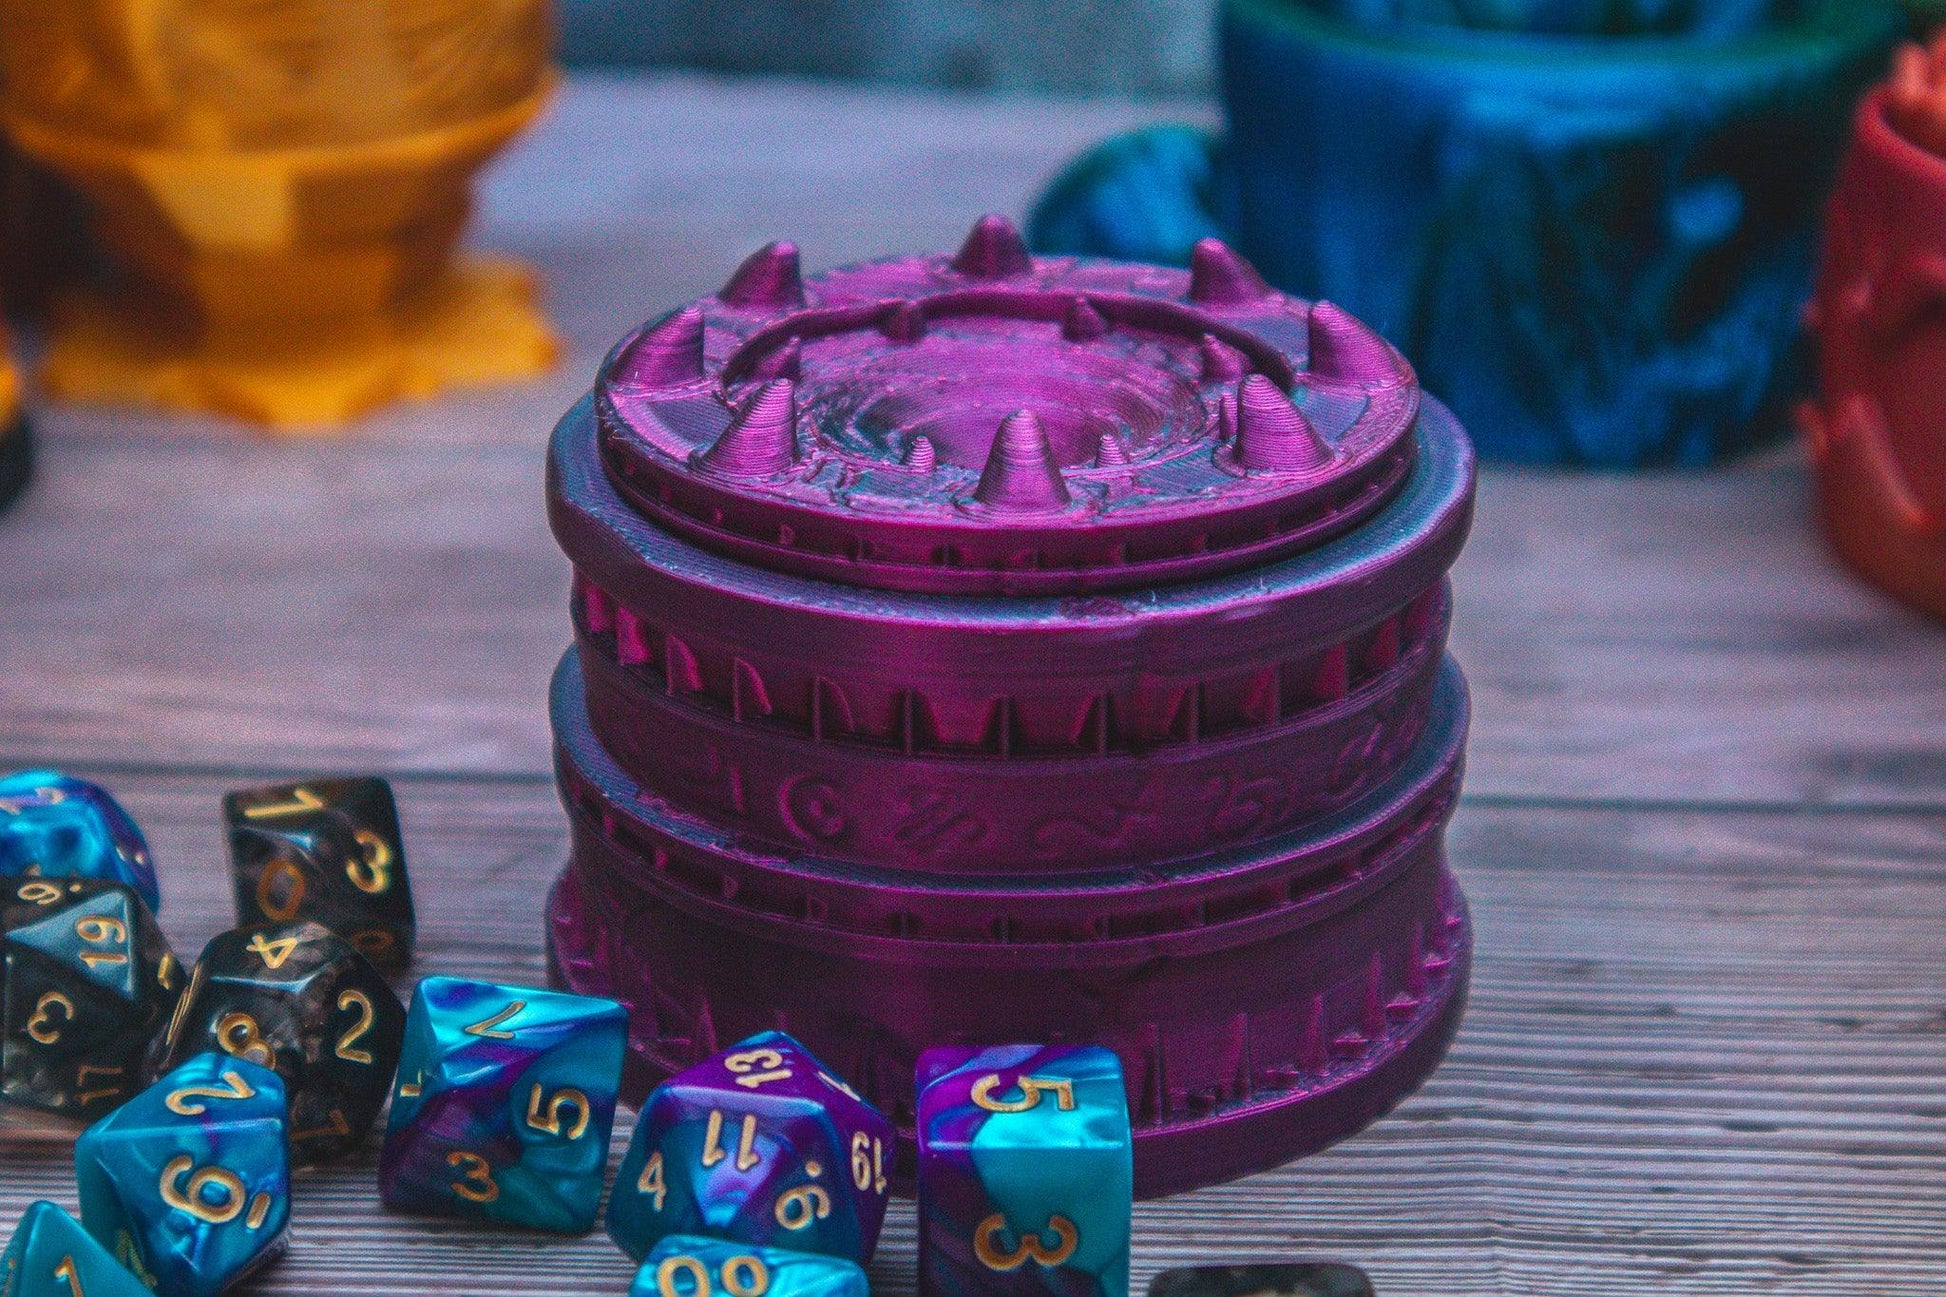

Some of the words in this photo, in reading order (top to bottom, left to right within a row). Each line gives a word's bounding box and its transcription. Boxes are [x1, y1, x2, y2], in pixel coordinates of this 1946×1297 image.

[346, 830, 393, 894] 3
[76, 915, 128, 968] 19
[246, 934, 298, 969] 4
[28, 991, 75, 1044] 3
[336, 990, 374, 1065] 2
[166, 1071, 256, 1115] 2
[725, 1050, 792, 1088] 13
[971, 1074, 1074, 1112] 5
[527, 1082, 590, 1139] 5
[702, 1110, 760, 1170] 11
[852, 1131, 887, 1195] 19
[446, 1151, 499, 1201] 3
[637, 1152, 667, 1212] 4
[974, 1212, 1078, 1272] 3
